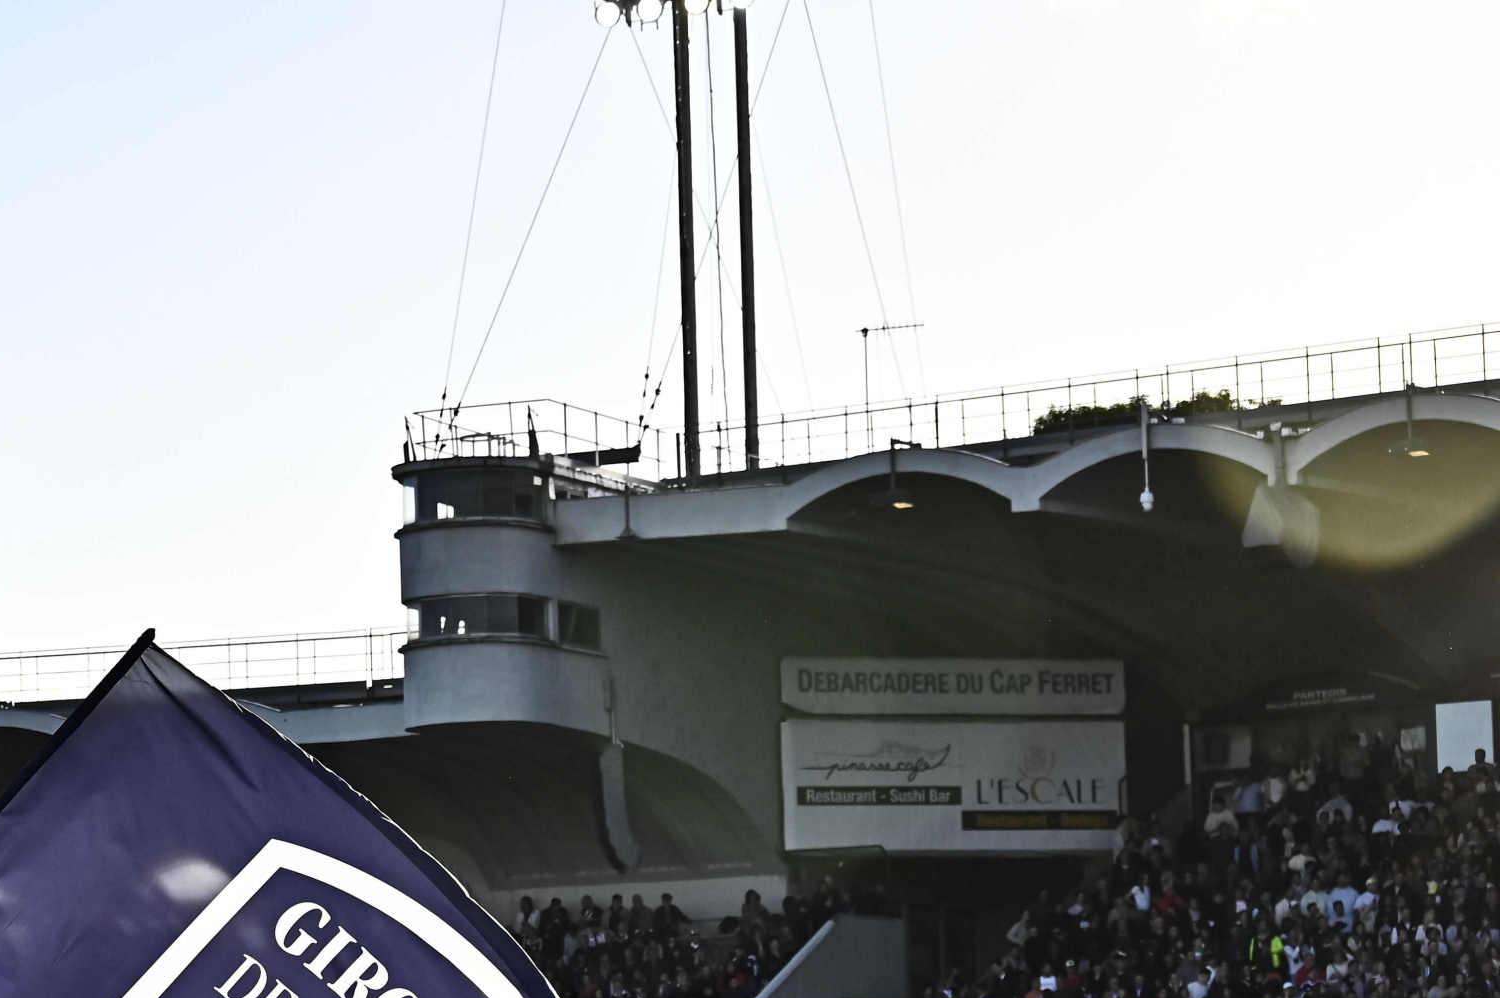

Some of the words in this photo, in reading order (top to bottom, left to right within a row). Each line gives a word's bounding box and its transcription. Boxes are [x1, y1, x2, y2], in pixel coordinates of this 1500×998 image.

[958, 672, 984, 695] DU
[989, 668, 1032, 696] CAP
[1037, 669, 1115, 695] FERRET
[805, 789, 877, 804] Restaurant
[889, 788, 926, 804] Sushi
[928, 789, 951, 804] Bar
[975, 777, 1106, 805] L'ESCALE
